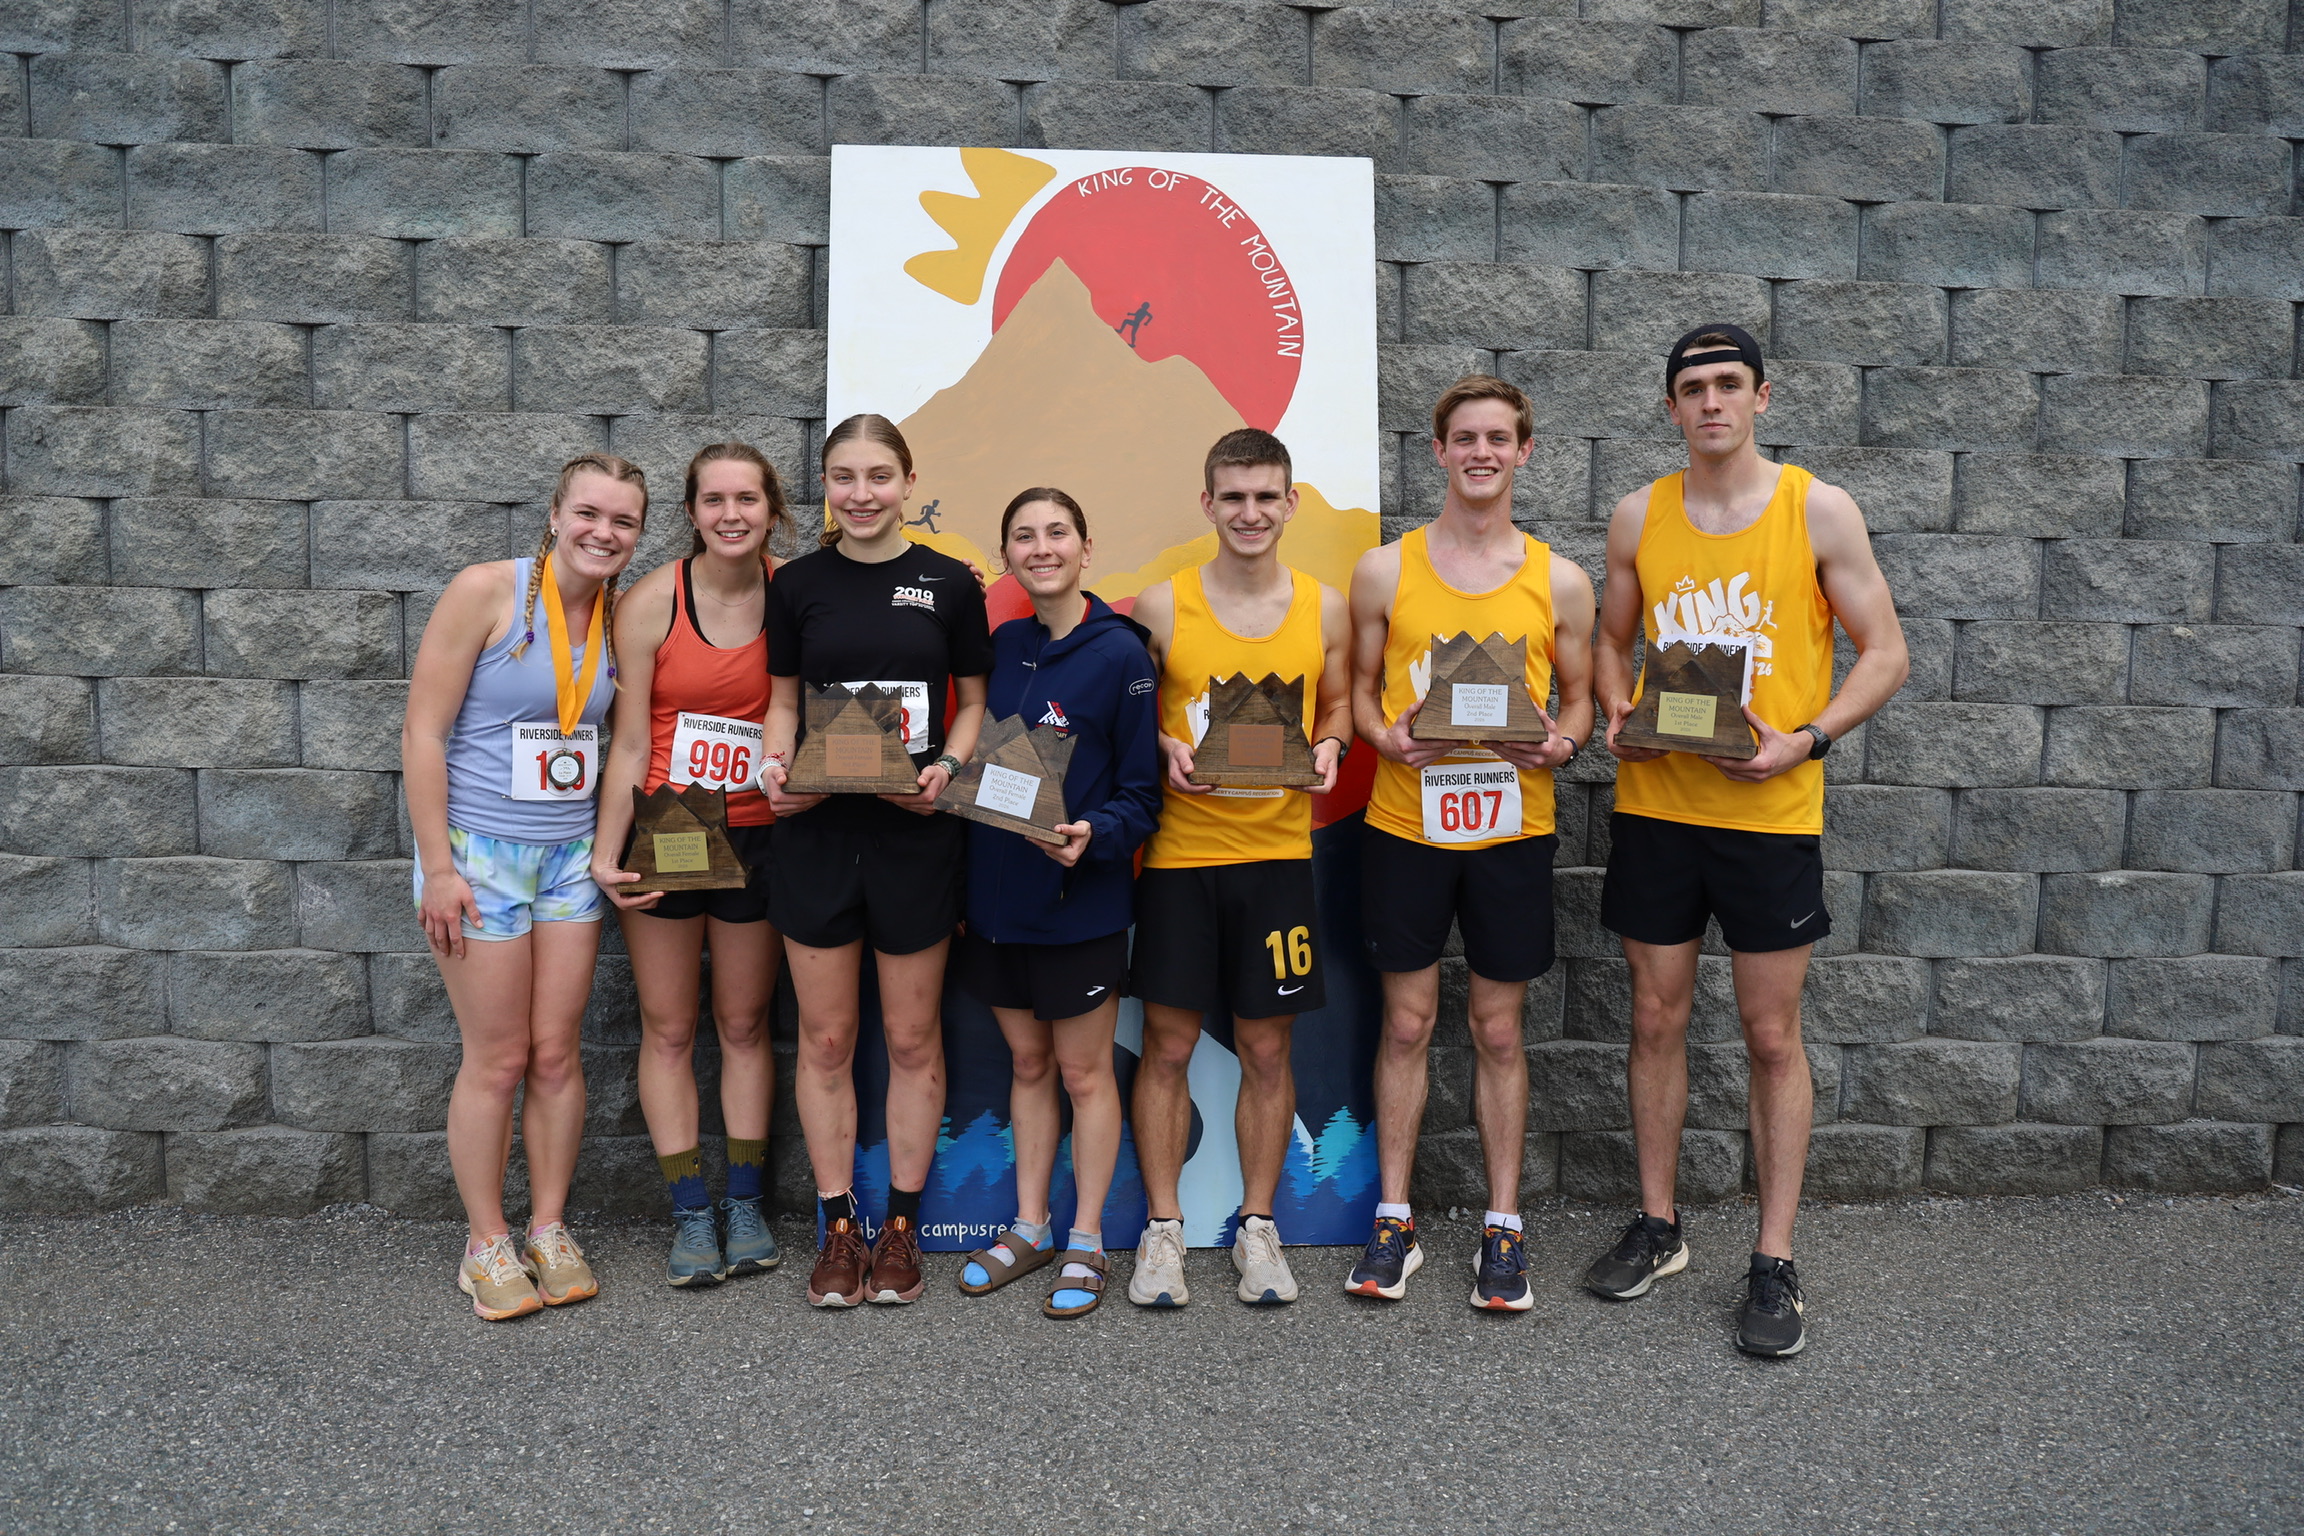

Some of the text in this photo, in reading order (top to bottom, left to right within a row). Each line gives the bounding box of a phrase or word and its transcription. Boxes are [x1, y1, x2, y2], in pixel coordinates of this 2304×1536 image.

[1077, 168, 1301, 358] KING OF THE MOUNTAIN
[893, 586, 934, 601] 2019
[1653, 571, 1760, 634] KING
[1669, 705, 1707, 714] MOUNTAIN
[1696, 698, 1711, 706] THE
[520, 728, 565, 740] RIVERSIDE
[683, 717, 763, 740] RIVERSIDE RUNNERS
[688, 739, 751, 784] 996
[990, 769, 1034, 787] KING OF THE
[991, 778, 1028, 793] MOUNTAIN
[1425, 771, 1515, 787] RIVERSIDE RUNNERS
[1440, 790, 1502, 832] 607
[663, 843, 698, 851] MOUNTAIN
[1265, 925, 1312, 980] 16
